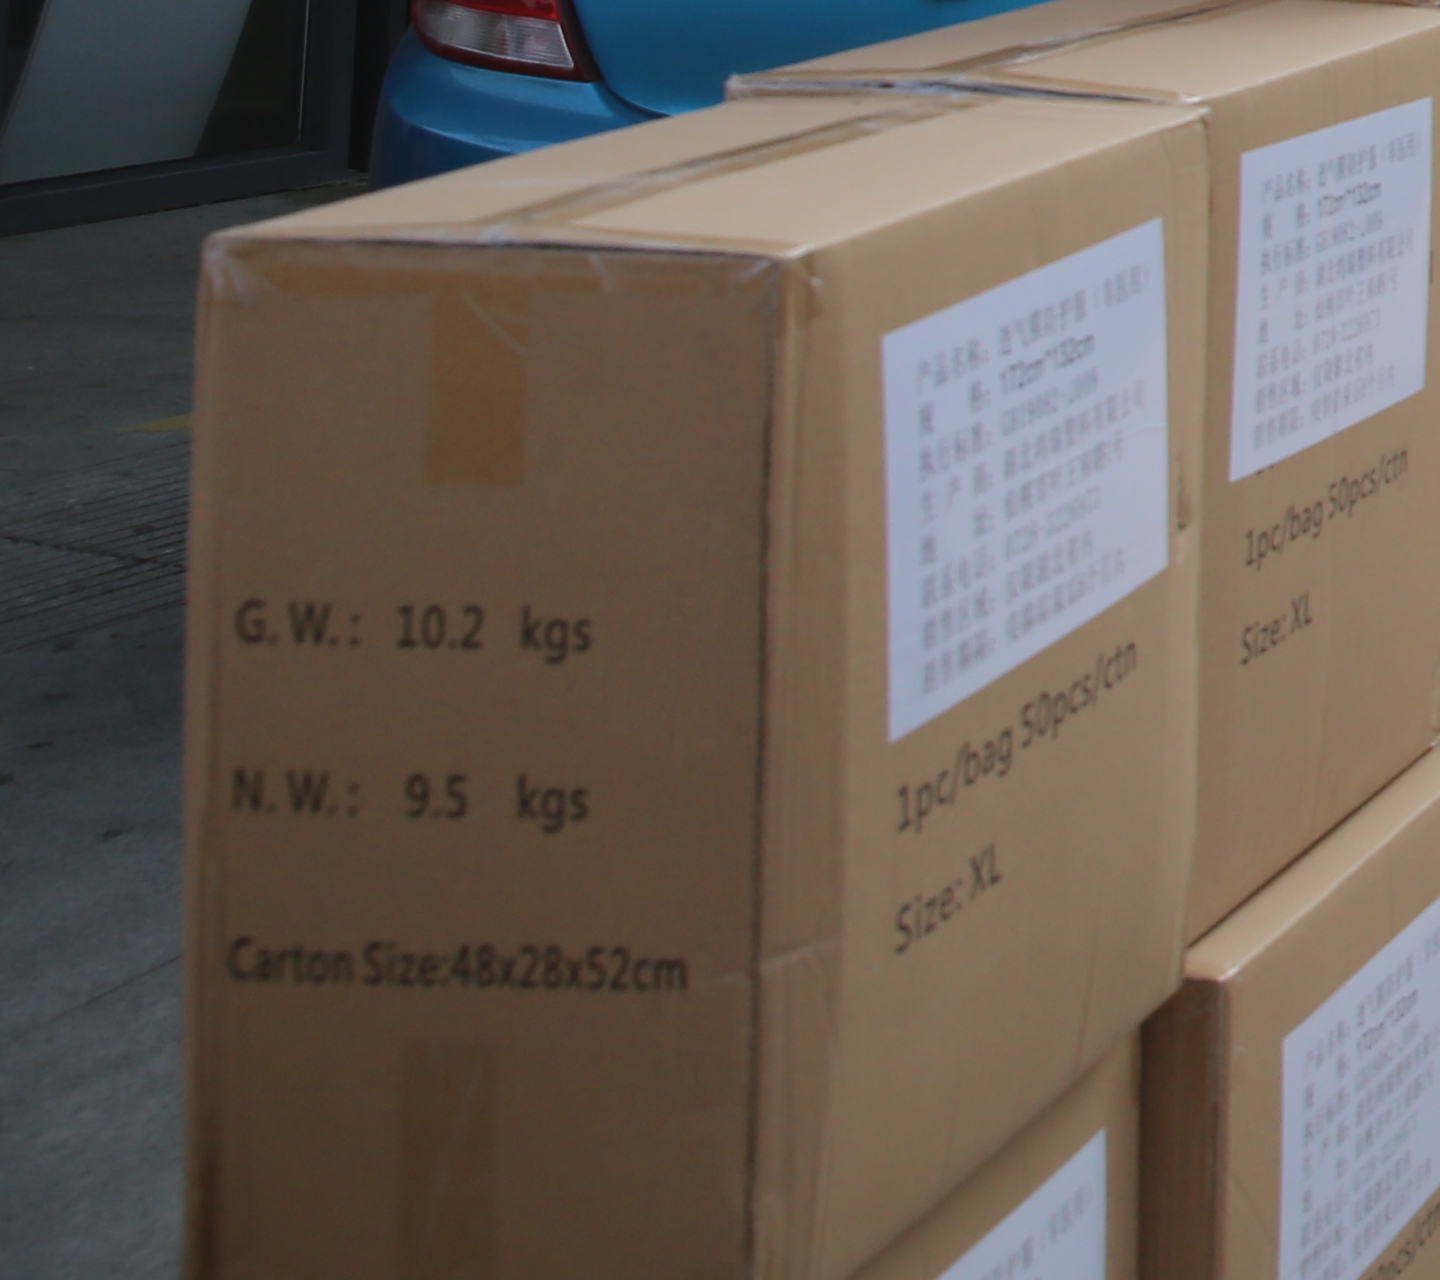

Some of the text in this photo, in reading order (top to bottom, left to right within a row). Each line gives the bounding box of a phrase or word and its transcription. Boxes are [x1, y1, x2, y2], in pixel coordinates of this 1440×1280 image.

[1244, 447, 1409, 572] 1pc/bag 50pcs/ctn
[395, 605, 486, 654] 10.2
[519, 605, 593, 668] kgs
[1240, 591, 1314, 666] Size: XL
[896, 637, 1139, 833] 1pc/bag 50pcs/ctn
[404, 773, 470, 822] 9.5
[515, 775, 590, 835] kgs
[895, 845, 1002, 954] Size: XL
[227, 936, 688, 994] Carton Size:48x28x52cm
